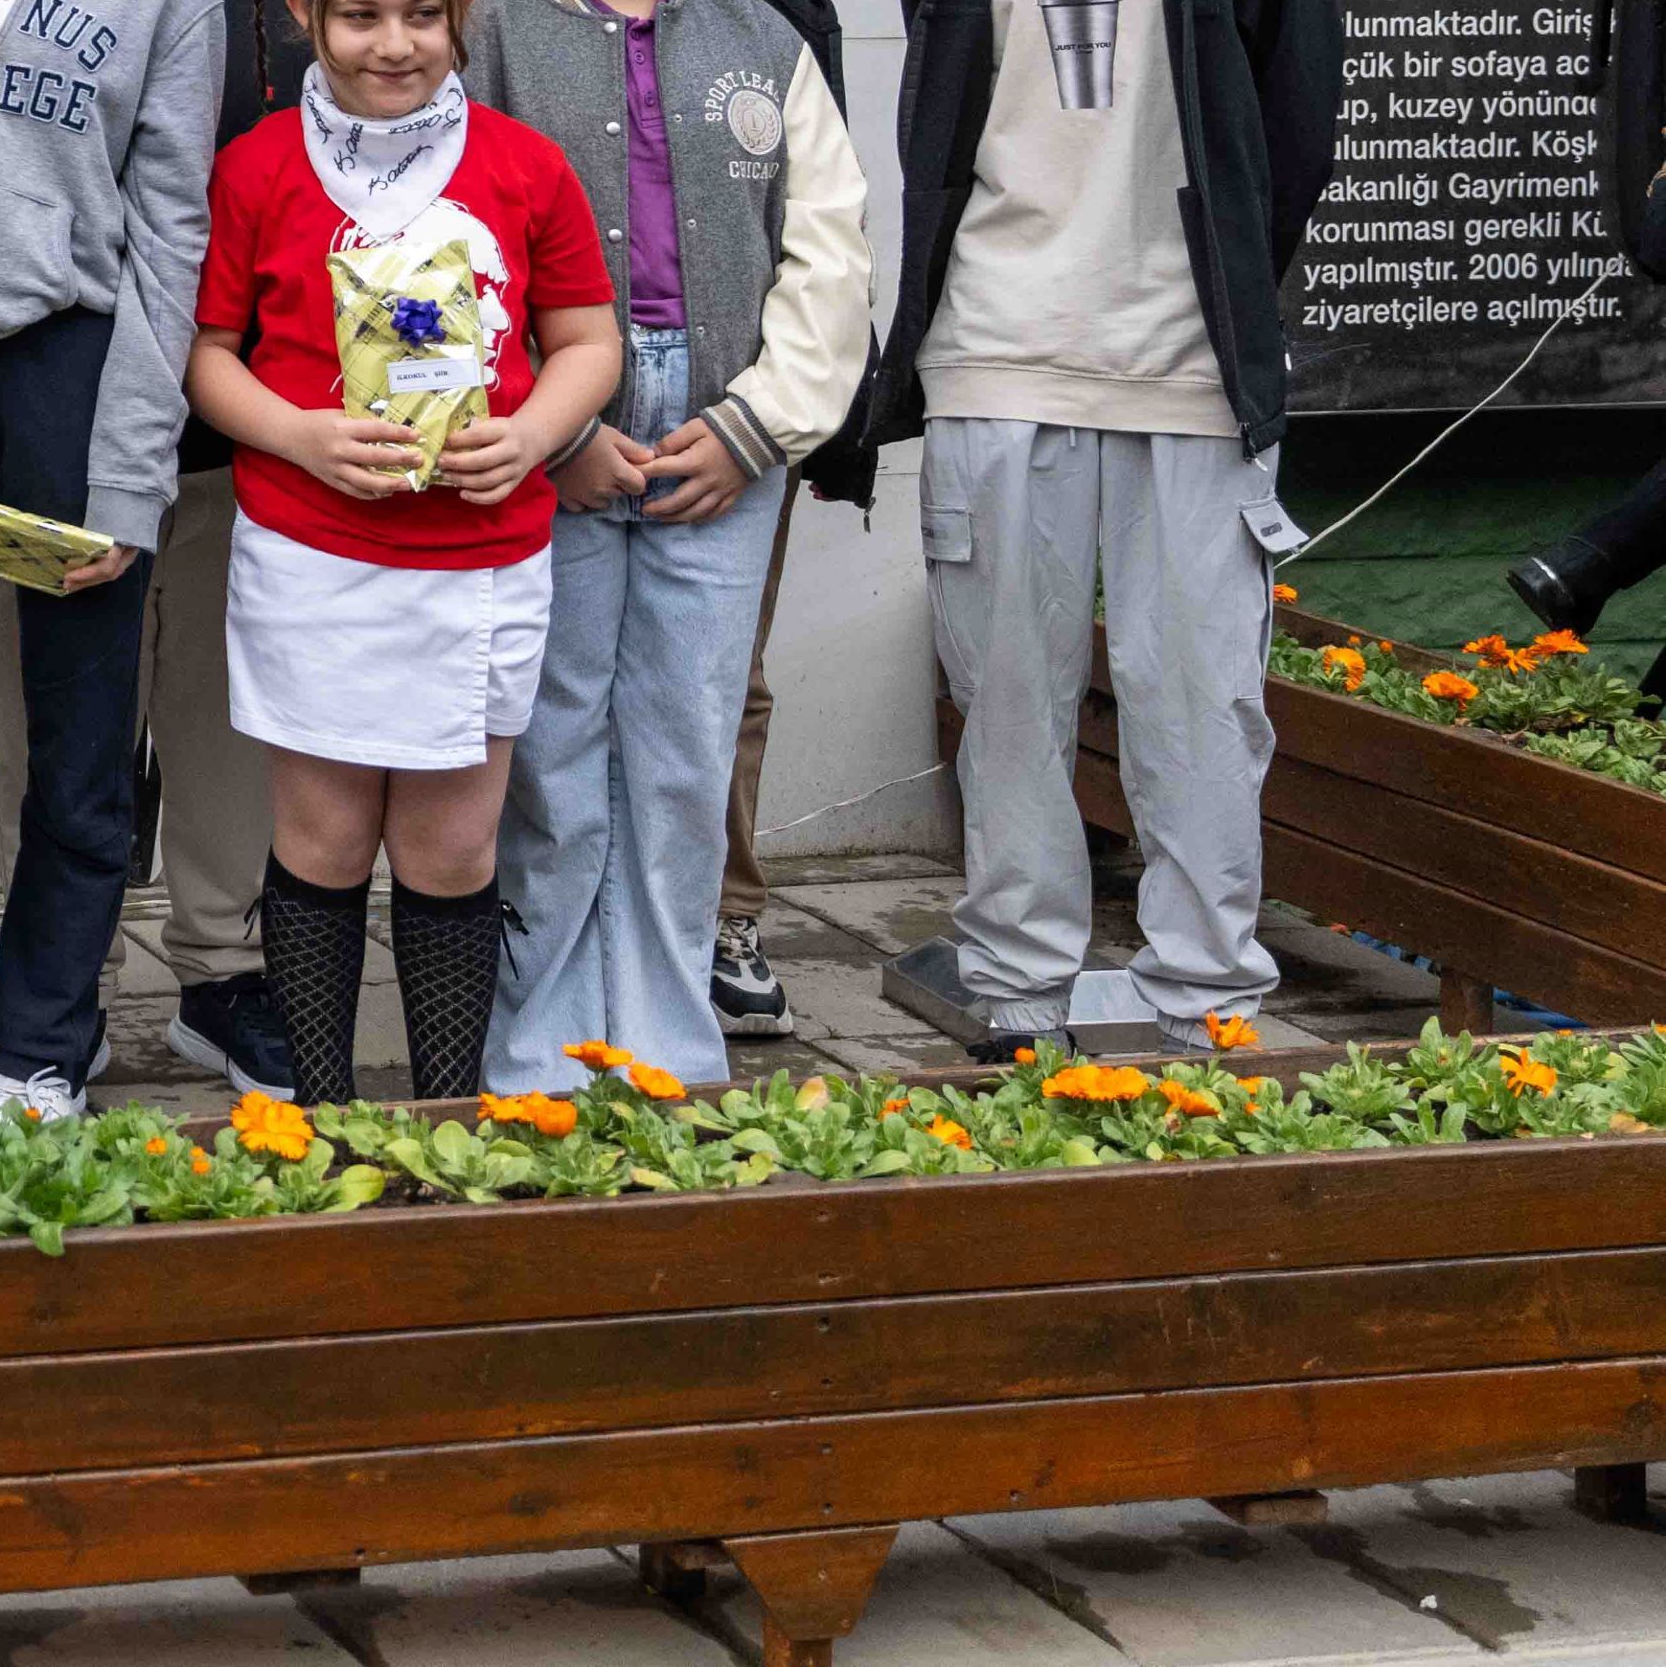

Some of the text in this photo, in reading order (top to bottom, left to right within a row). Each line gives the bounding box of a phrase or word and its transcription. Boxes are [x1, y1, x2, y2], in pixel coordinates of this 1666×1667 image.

[1346, 10, 1521, 37] lunmaktadır.
[1055, 41, 1112, 51] JUST FOR YOU
[1405, 51, 1443, 77] bir
[1451, 50, 1547, 82] sofaya
[705, 72, 739, 122] SPORT
[1389, 93, 1473, 124] kuzey
[1306, 218, 1454, 243] korunması
[1465, 212, 1560, 245] gerekli
[1304, 257, 1457, 291] yapılmıştır.
[1469, 253, 1537, 279] 2006
[1303, 292, 1622, 331] ziyaretçilere açılmıştır.
